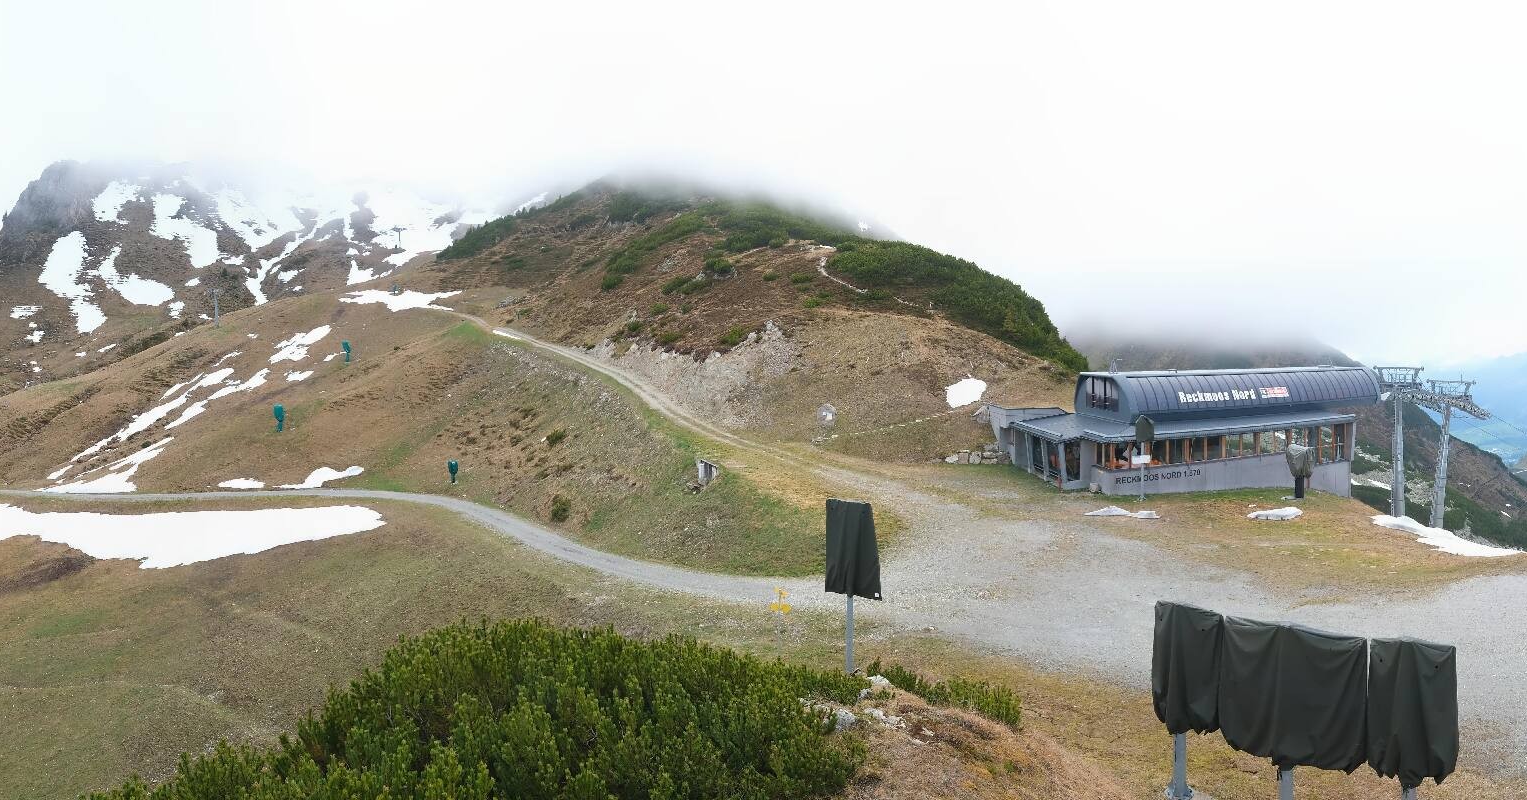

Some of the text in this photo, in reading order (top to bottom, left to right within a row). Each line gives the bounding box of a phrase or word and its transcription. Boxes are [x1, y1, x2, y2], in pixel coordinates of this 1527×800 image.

[1178, 390, 1230, 403] Reckmoos
[1231, 389, 1256, 400] Nord
[1161, 471, 1182, 480] NORD
